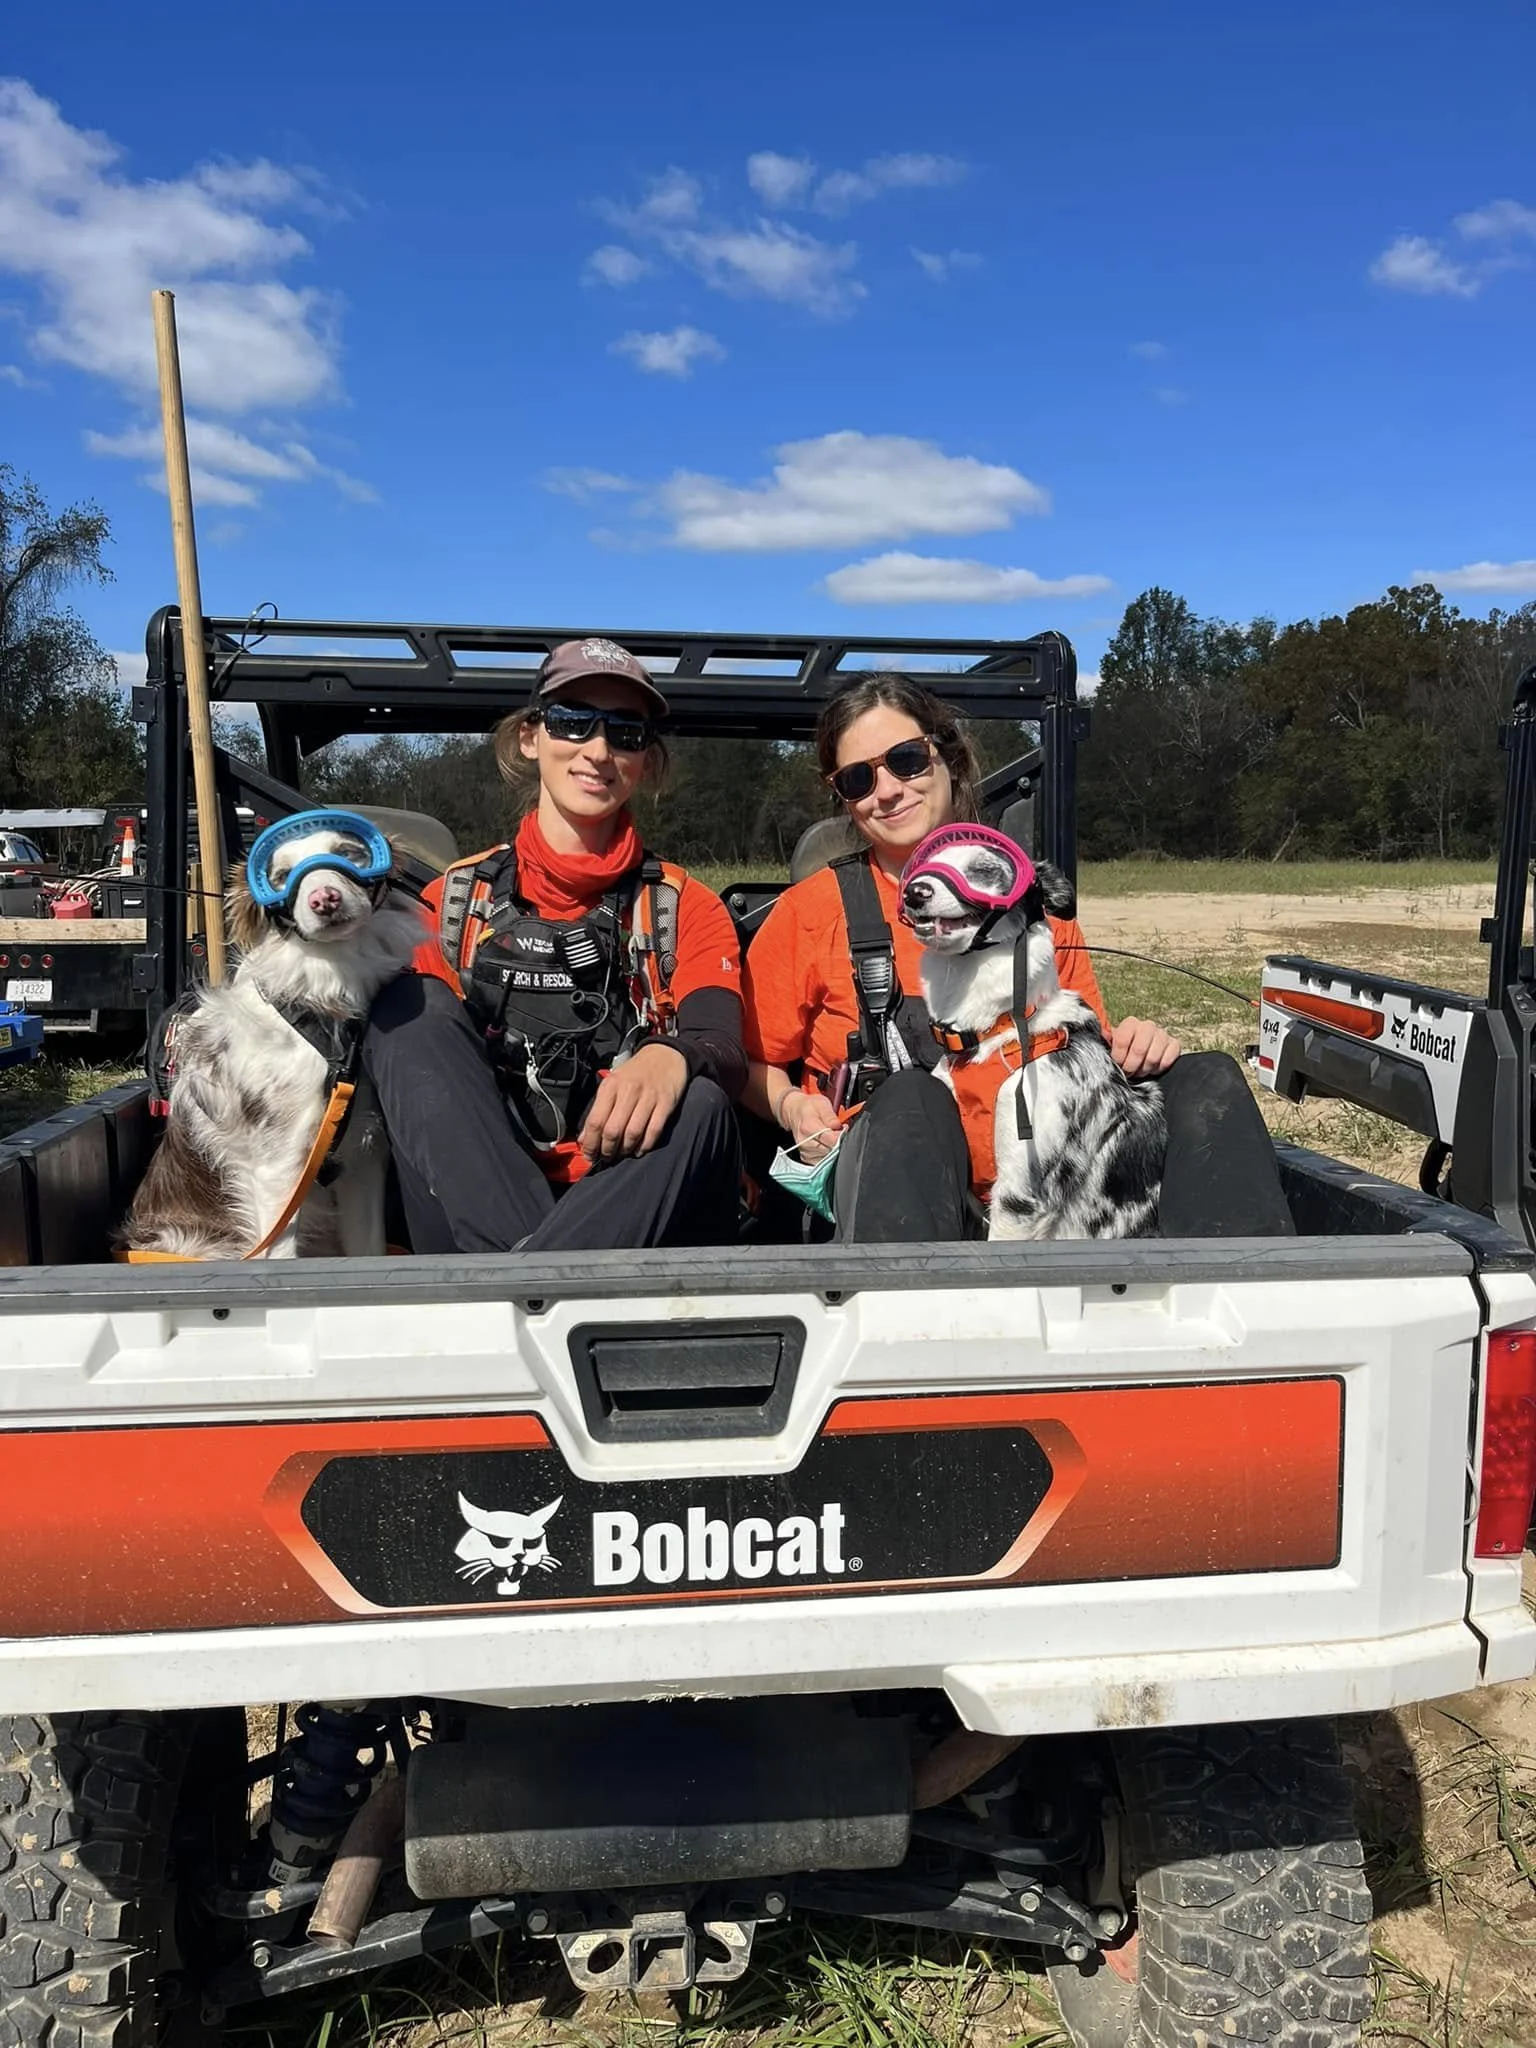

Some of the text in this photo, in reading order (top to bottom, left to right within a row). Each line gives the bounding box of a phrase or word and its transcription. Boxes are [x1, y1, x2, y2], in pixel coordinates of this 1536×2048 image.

[502, 969, 531, 986] SRCH
[533, 973, 540, 986] &
[1410, 1023, 1456, 1063] Bobcat
[592, 1502, 846, 1586] Bobcat
